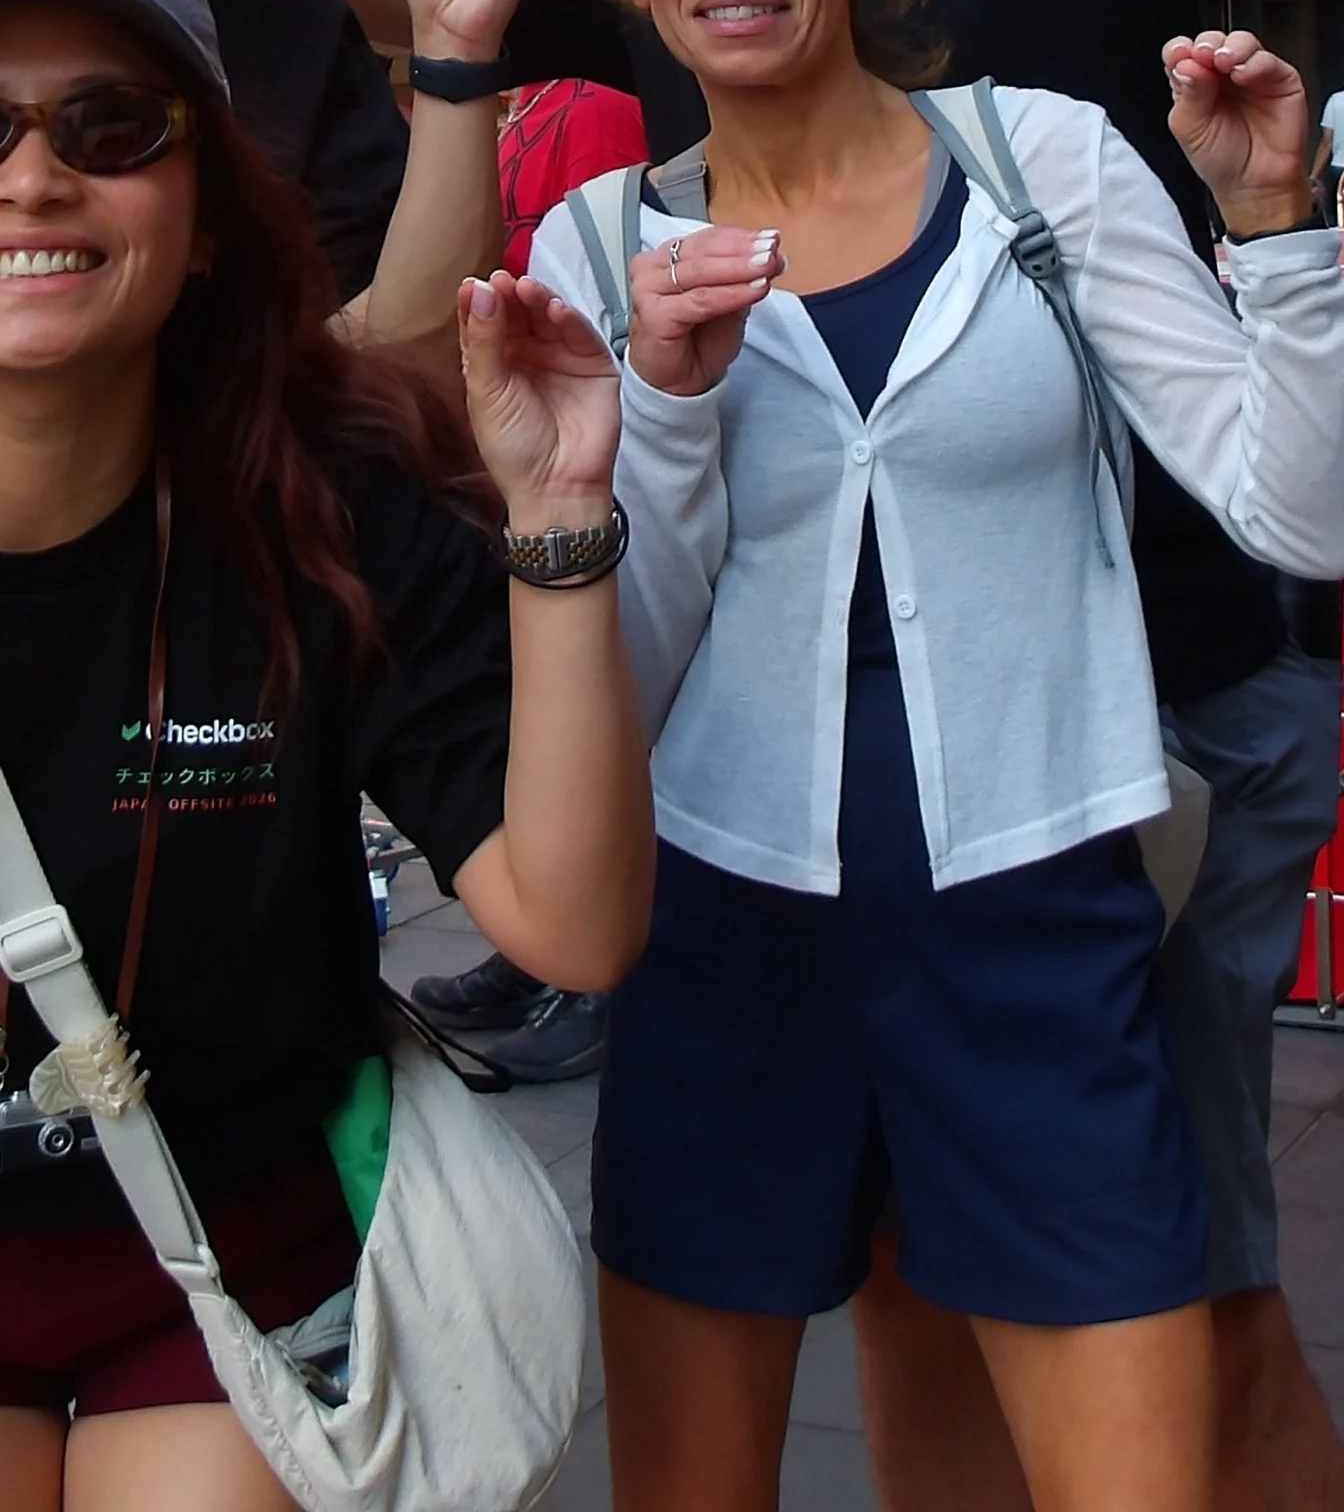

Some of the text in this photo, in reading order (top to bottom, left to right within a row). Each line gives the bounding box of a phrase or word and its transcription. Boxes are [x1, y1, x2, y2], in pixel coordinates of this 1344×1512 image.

[145, 718, 275, 744] Checkbox
[115, 763, 276, 785] チェックボックス
[112, 797, 148, 812] JAPA
[168, 796, 234, 811] OFFSITE
